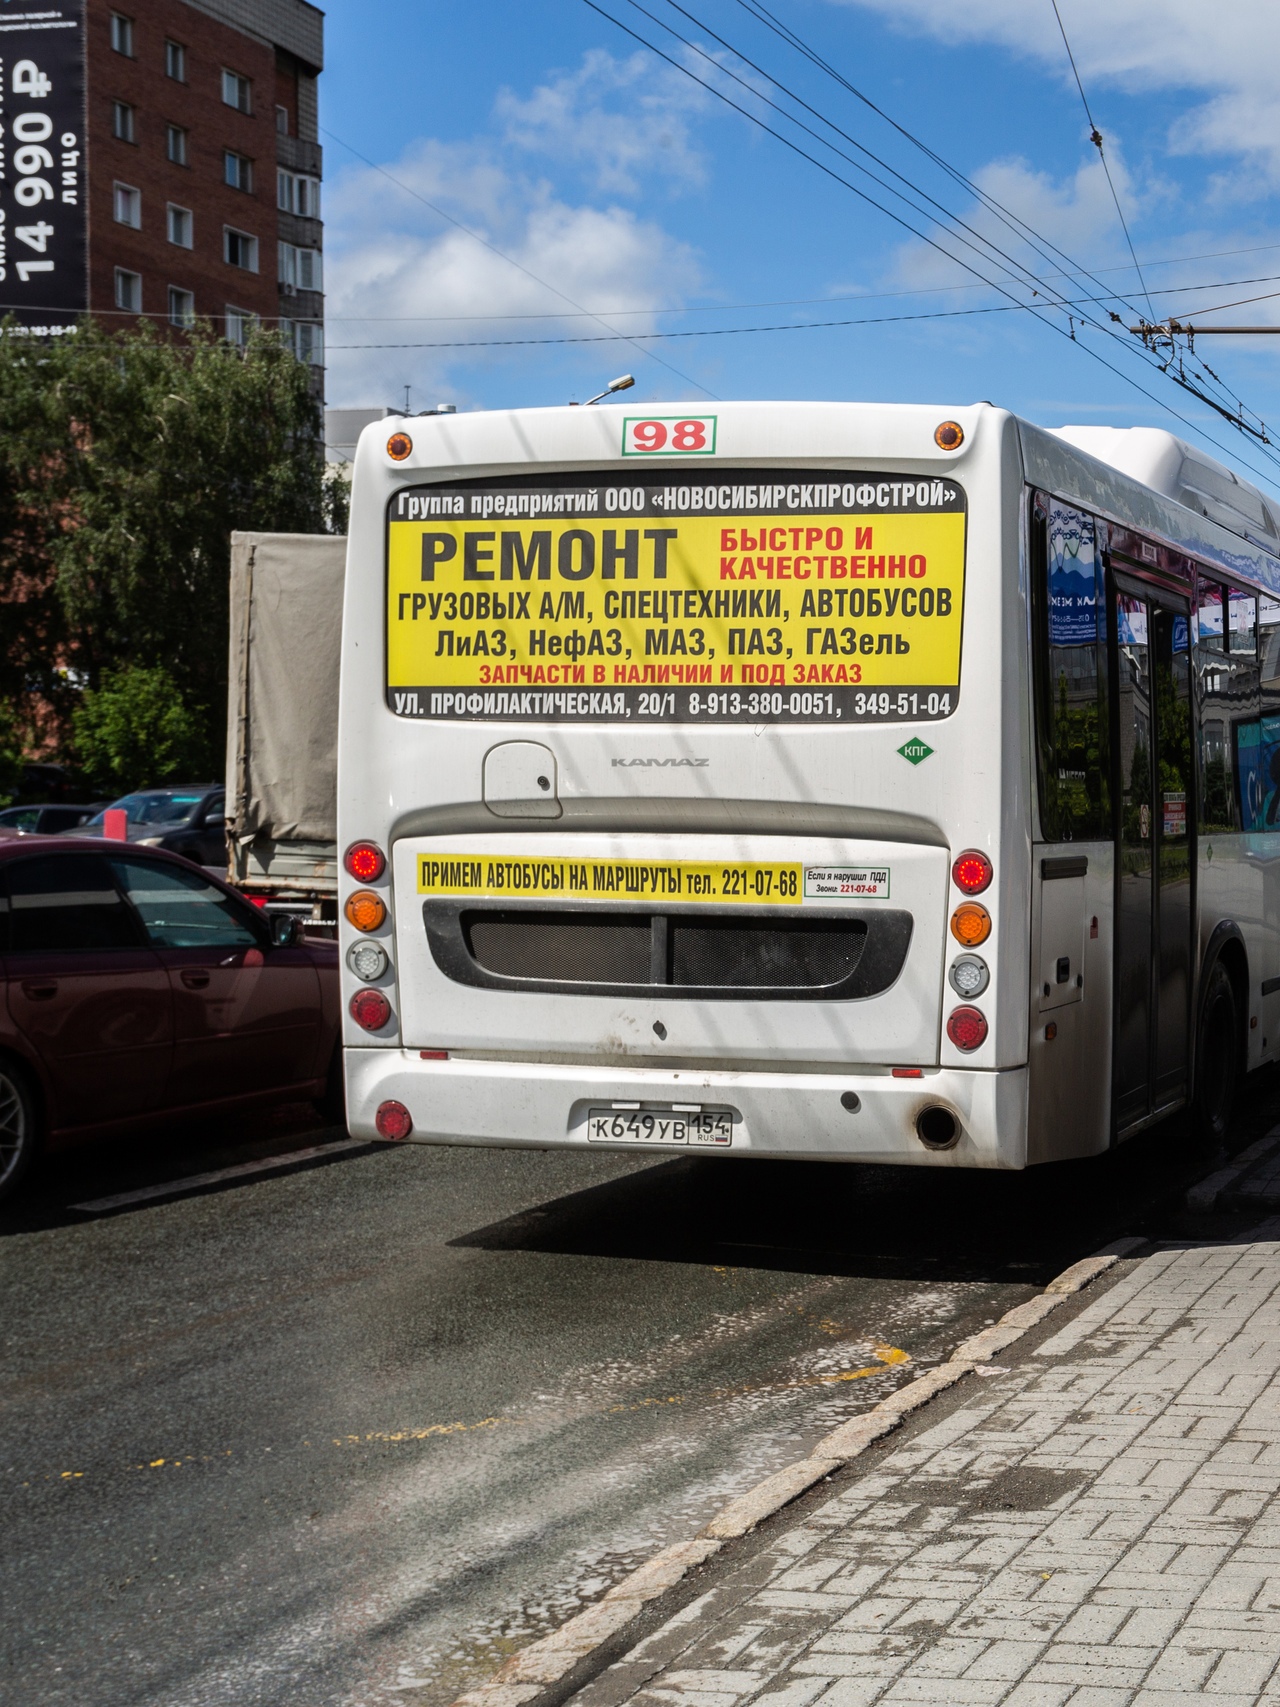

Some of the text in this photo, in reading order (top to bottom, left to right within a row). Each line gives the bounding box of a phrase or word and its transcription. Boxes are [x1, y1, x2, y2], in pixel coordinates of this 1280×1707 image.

[12, 112, 55, 207] 990
[61, 132, 80, 205] лицо
[12, 221, 55, 282] 14
[633, 420, 706, 452] 98
[397, 480, 956, 519] Группа предприятий ООО «НОВОСИБИРСКПРОФСТРОЙ»
[720, 526, 873, 552] БЫСТРО И
[420, 529, 678, 582] РЕМОНТ
[719, 554, 927, 580] КАЧЕСТВЕННО
[398, 587, 952, 624] ГРУЗОВЫХ А/М, СПЕЦТЕХНИКИ, АВТОБУСОВ
[435, 627, 911, 662] ЛиАЗ, НефАЗ, МАЗ, ПАЗ, ГАЗель
[479, 663, 862, 687] ЗАПЧАСТИ В НАЛИЧИИ И ПОД ЗАКАЗ
[394, 692, 951, 718] УЛ. ПРОФИЛАКТИЧЕСКАЯ, 20/1 8-913-380-0051, 349-51-04
[904, 746, 927, 757] КПГ
[422, 861, 797, 897] ПРИМЕМ АВТОБУСЫ НА МАРШРУТЫ тел. 221-07-68
[807, 871, 887, 883] Если я нарушил ПДД
[840, 884, 877, 894] 221-07-68
[691, 1115, 726, 1135] 154
[697, 1134, 715, 1142] RUS
